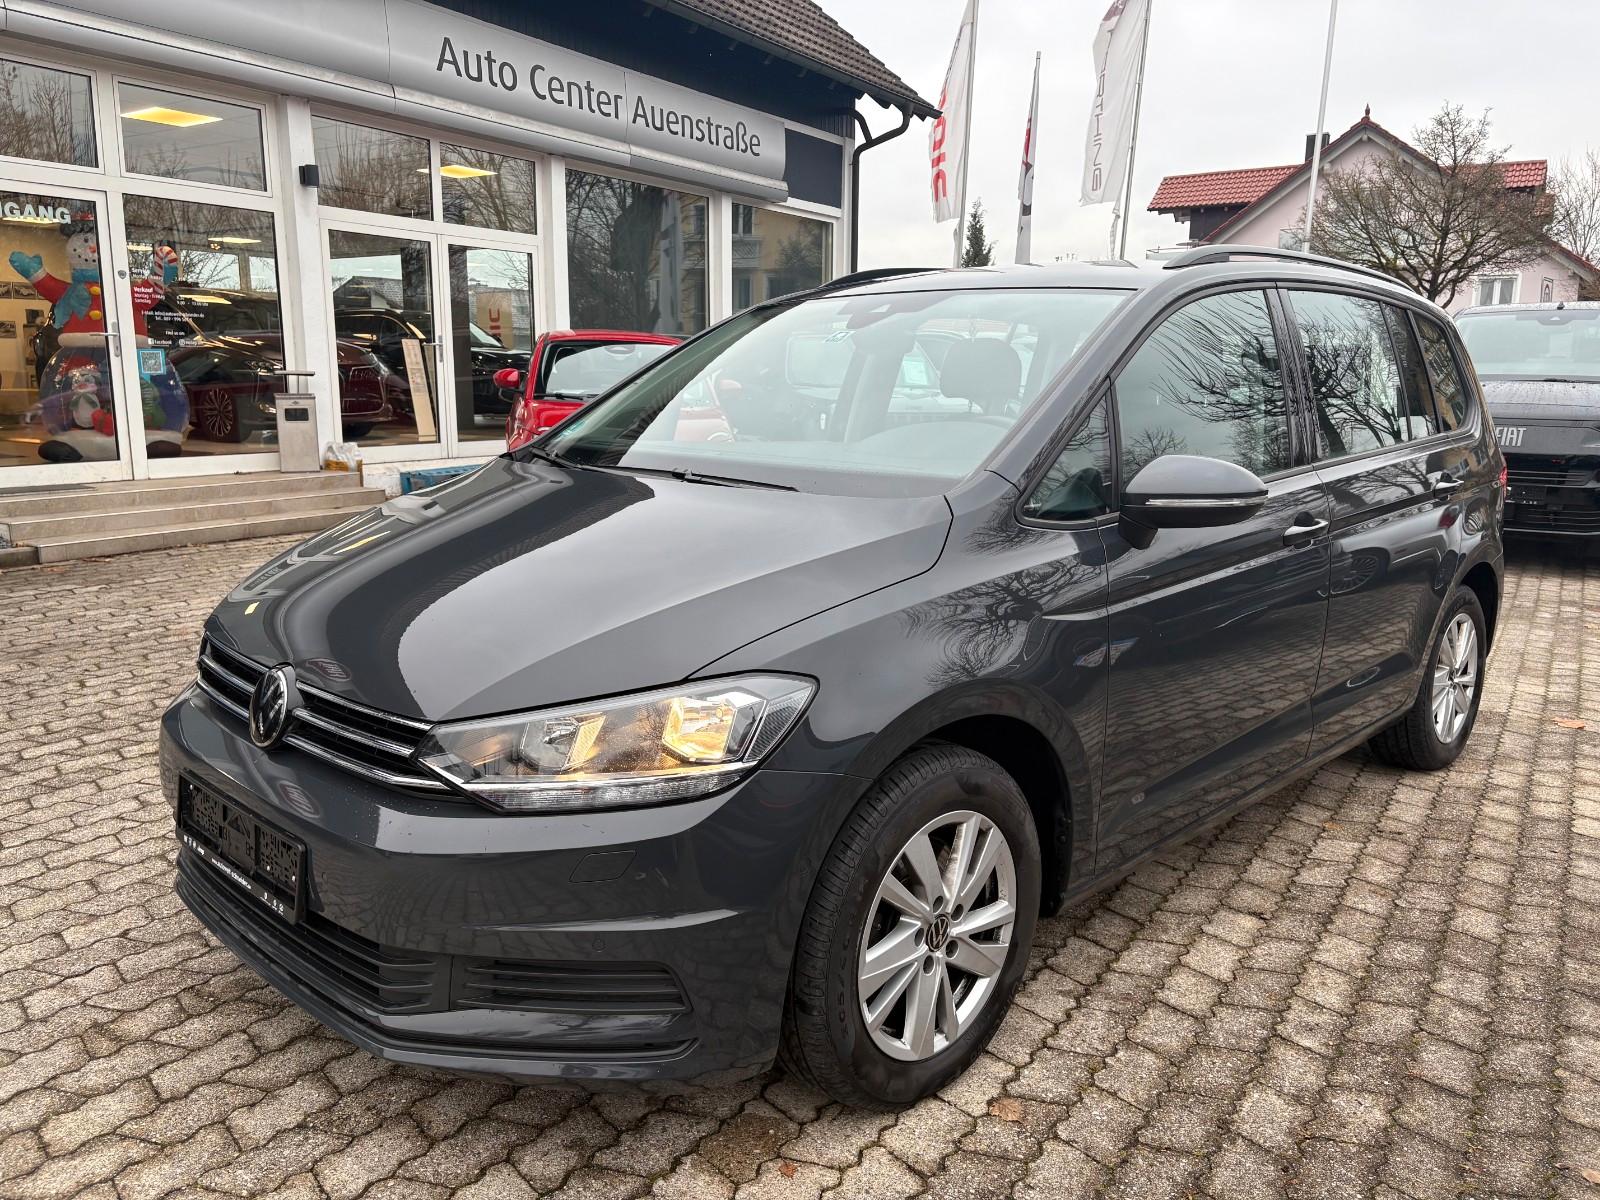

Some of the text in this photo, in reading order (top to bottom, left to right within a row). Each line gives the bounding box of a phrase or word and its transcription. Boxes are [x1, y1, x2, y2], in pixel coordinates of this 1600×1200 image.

[436, 36, 761, 157] Auto Center Auenstraße
[0, 201, 71, 224] GANG
